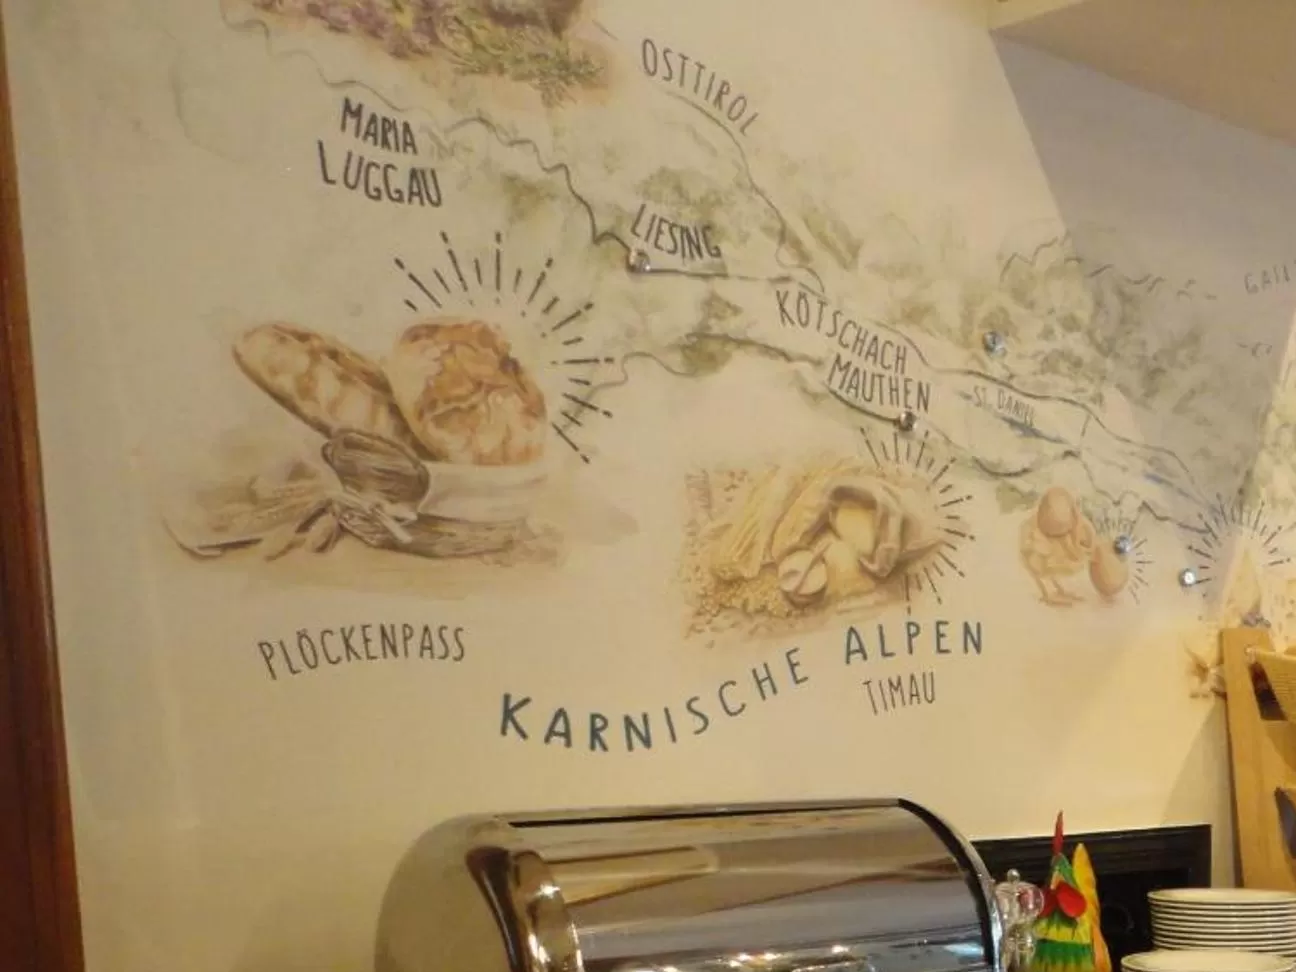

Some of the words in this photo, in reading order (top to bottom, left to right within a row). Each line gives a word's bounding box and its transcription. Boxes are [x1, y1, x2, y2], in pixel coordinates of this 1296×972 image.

[641, 38, 758, 136] OSTTIROL
[339, 97, 418, 156] MARIA
[316, 140, 442, 208] LUGGAU
[632, 203, 722, 260] LIESING
[775, 289, 907, 375] KÖTSCHACH
[829, 352, 931, 413] MAUTHEN
[258, 624, 466, 681] PLÖCKENPASS
[499, 645, 810, 753] KARNISCHE
[843, 619, 985, 666] ALPEN
[864, 670, 938, 716] TIMAU
